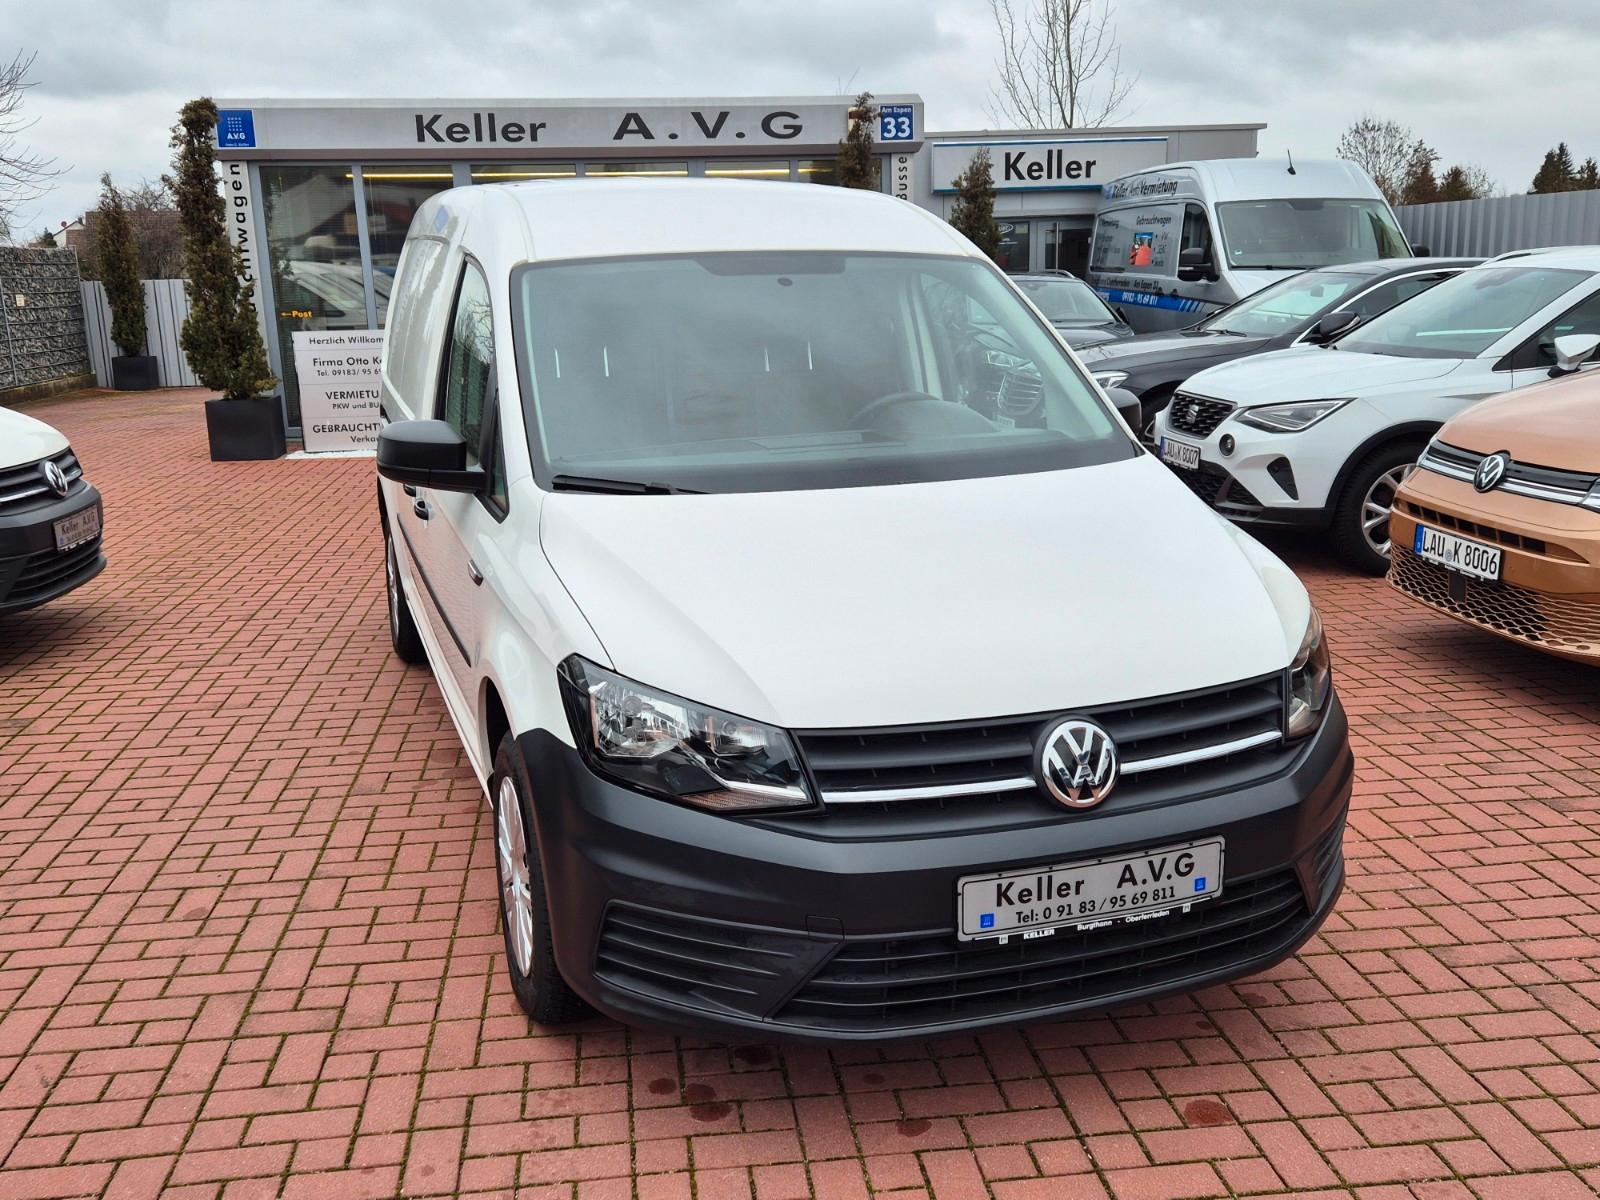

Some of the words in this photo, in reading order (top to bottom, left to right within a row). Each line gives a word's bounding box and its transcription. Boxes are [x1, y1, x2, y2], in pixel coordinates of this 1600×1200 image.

[893, 106, 912, 115] Espen
[415, 112, 546, 143] Keller
[612, 111, 803, 141] A.V.G
[883, 117, 910, 138] 33
[1004, 149, 1097, 181] Keller
[291, 310, 313, 318] Post
[309, 335, 345, 345] Herzlich
[313, 357, 343, 367] Firma
[346, 356, 369, 366] Otto
[325, 390, 379, 400] VERMIETU
[1182, 446, 1199, 466] 8007
[1422, 530, 1446, 558] LAU
[1453, 540, 1462, 564] K
[1464, 545, 1498, 575] 8006
[996, 875, 1085, 908] Keller
[1116, 852, 1196, 889] A.V.G
[1015, 909, 1039, 924] Tel:
[1043, 907, 1052, 920] 0
[1056, 903, 1074, 918] 91
[1079, 900, 1096, 914] 83
[1109, 895, 1127, 909] 95
[1131, 891, 1148, 906] 69
[1152, 886, 1176, 902] 811
[1023, 928, 1055, 940] KELLER
[1077, 920, 1113, 932] Burgthann
[1125, 909, 1170, 924] Oberferrieden
